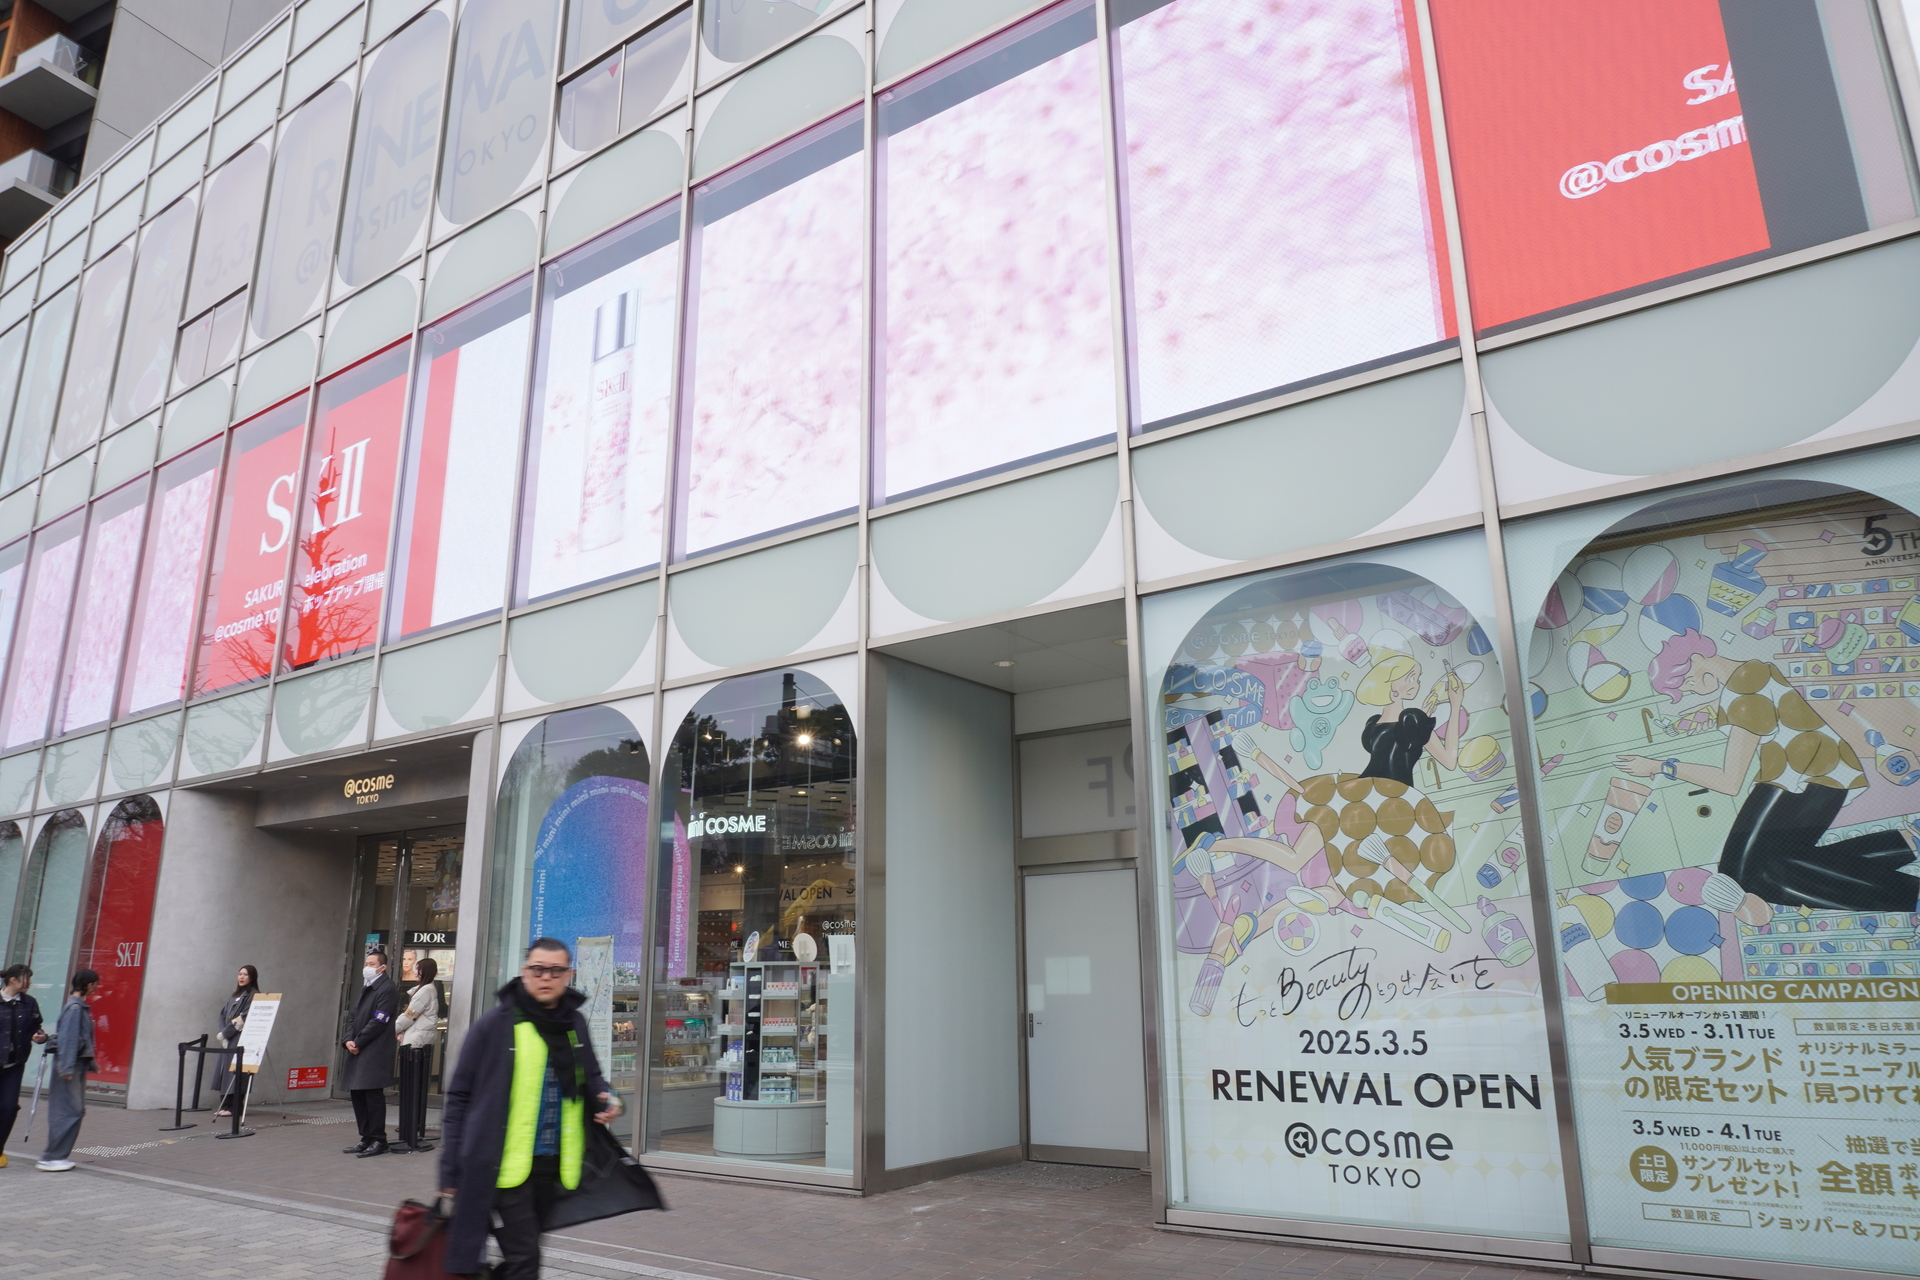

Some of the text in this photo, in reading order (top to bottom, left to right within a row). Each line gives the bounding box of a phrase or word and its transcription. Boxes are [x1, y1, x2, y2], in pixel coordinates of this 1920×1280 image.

[213, 613, 267, 643] @cosme
[1191, 631, 1261, 650] @cosme
[1193, 667, 1265, 707] COSME
[344, 774, 395, 798] @cosme
[356, 793, 379, 805] TOKYO
[705, 815, 767, 835] COSME
[799, 886, 832, 901] OPEN
[821, 920, 856, 931] @cosme
[413, 932, 446, 943] DIOR
[115, 942, 144, 968] SK-II
[1671, 981, 1920, 1001] OPENING CAMPAIGN
[1619, 1023, 1650, 1038] 3.5
[1653, 1028, 1685, 1038] WED
[1704, 1023, 1744, 1039] 3.11
[1748, 1028, 1776, 1039] TUE
[1299, 1029, 1428, 1056] 2025.3.5
[1798, 1042, 1920, 1055] オリジナルミラー
[1620, 1045, 1783, 1074] 人気ブランド
[1800, 1060, 1920, 1078] リニューアル
[1212, 1069, 1542, 1110] RENEWAL OPEN
[1624, 1076, 1788, 1104] の限定セット
[1284, 1121, 1454, 1161] @cosme
[1632, 1119, 1665, 1136] 3.5
[1667, 1125, 1701, 1137] WED
[1720, 1123, 1751, 1140] 4.1
[1754, 1129, 1782, 1142] TUE
[1638, 1153, 1667, 1168] 土日
[1682, 1155, 1802, 1177] サンプルセット
[1328, 1163, 1421, 1189] TOKYO
[1640, 1168, 1670, 1184] 限定
[1817, 1160, 1895, 1196] 全額
[1670, 1208, 1722, 1222] 数量限定
